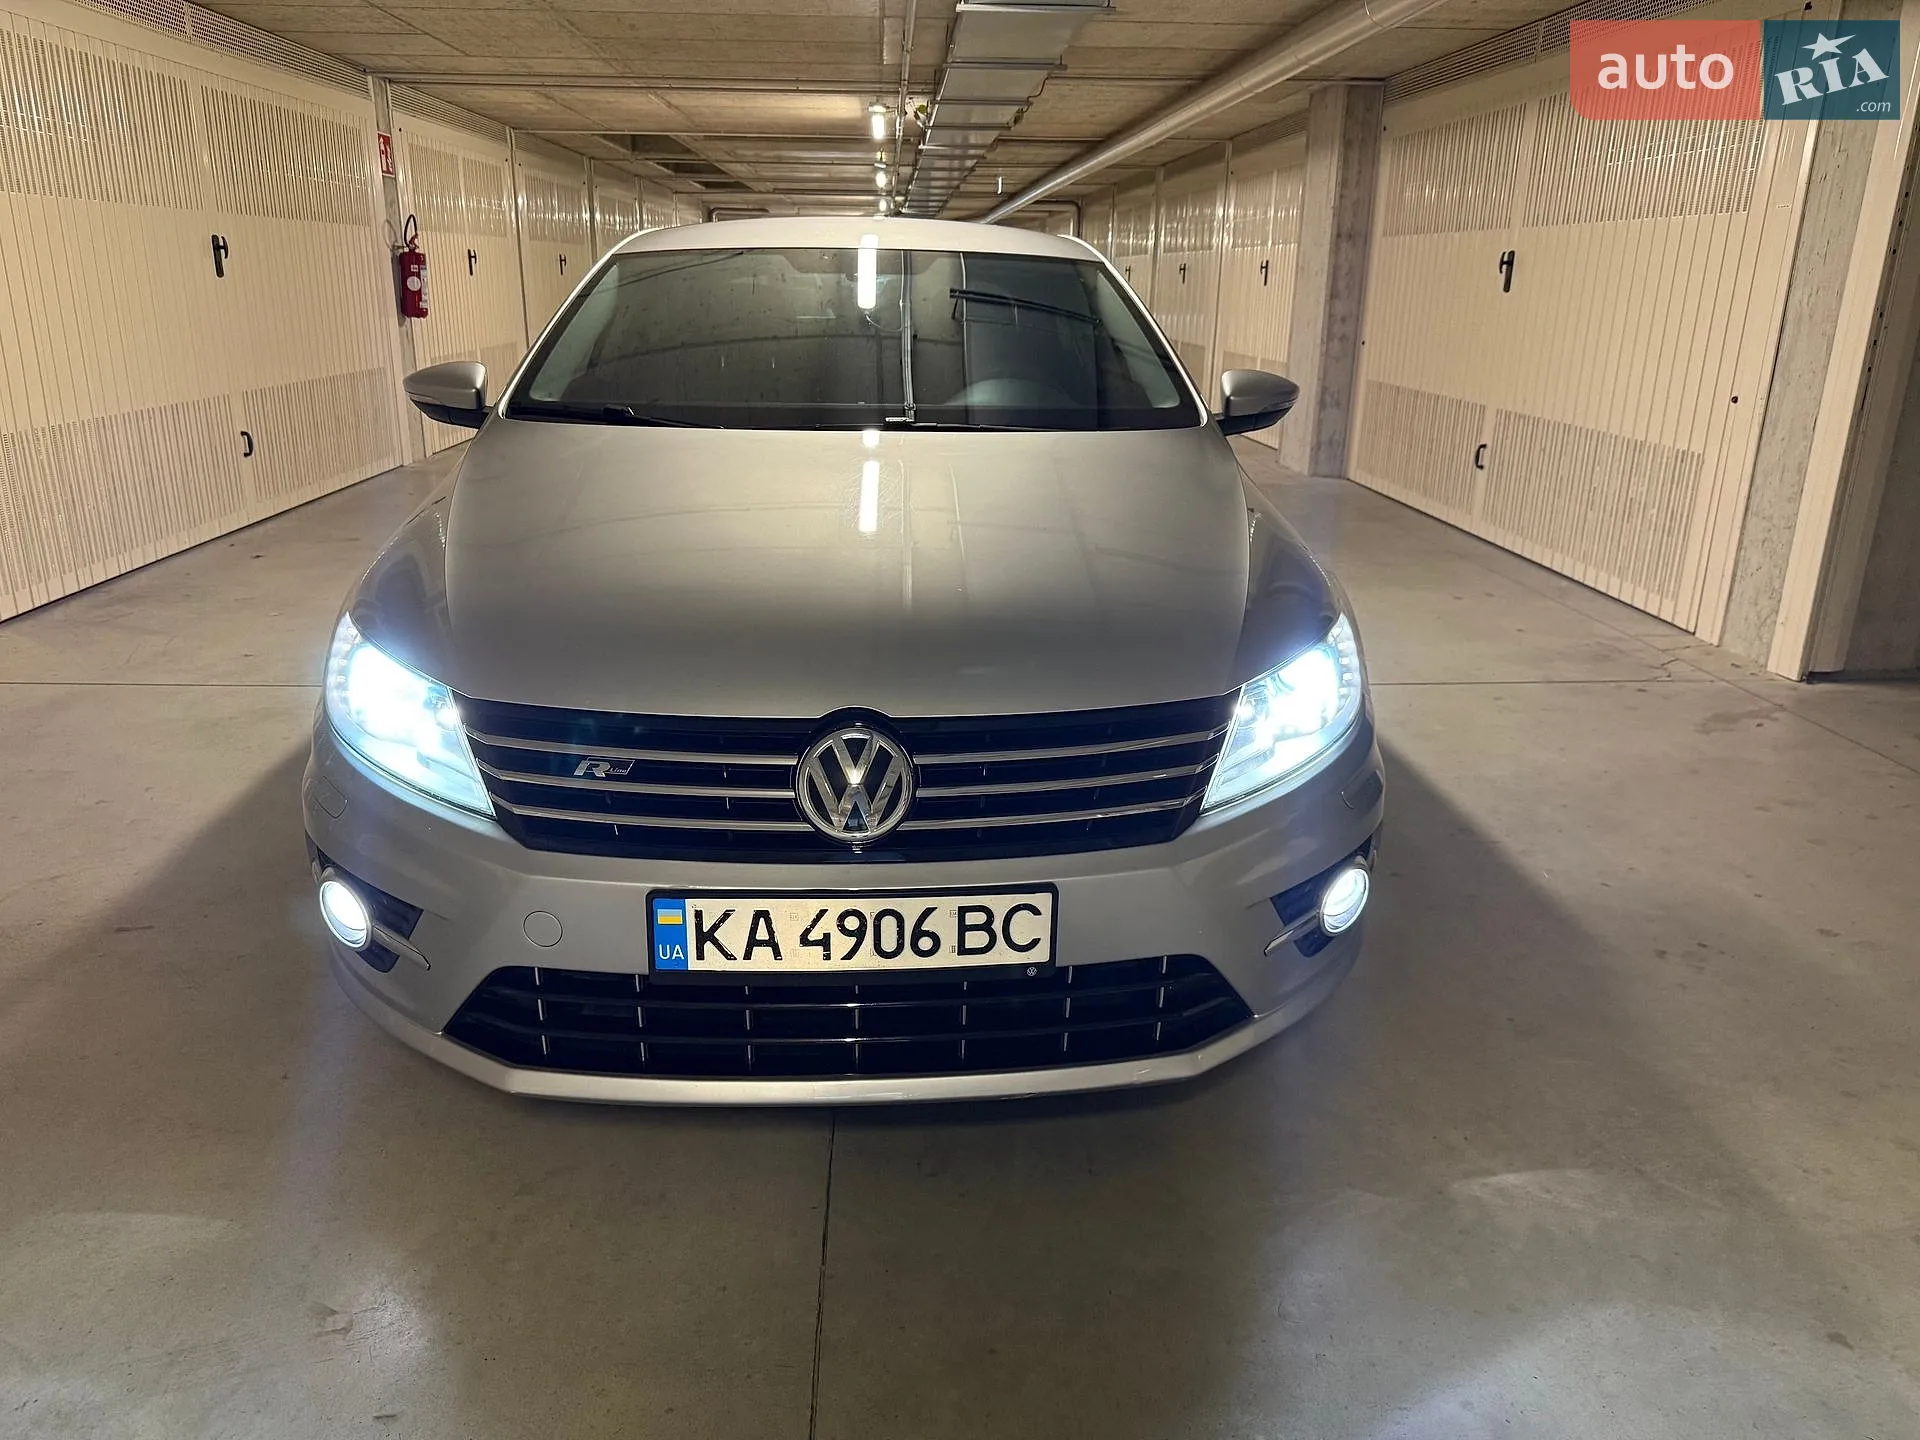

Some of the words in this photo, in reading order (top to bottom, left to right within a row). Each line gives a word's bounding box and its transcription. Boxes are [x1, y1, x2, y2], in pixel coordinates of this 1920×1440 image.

[694, 909, 783, 960] KA
[799, 907, 941, 961] 4906
[957, 903, 1042, 957] BC
[659, 945, 684, 960] UA
